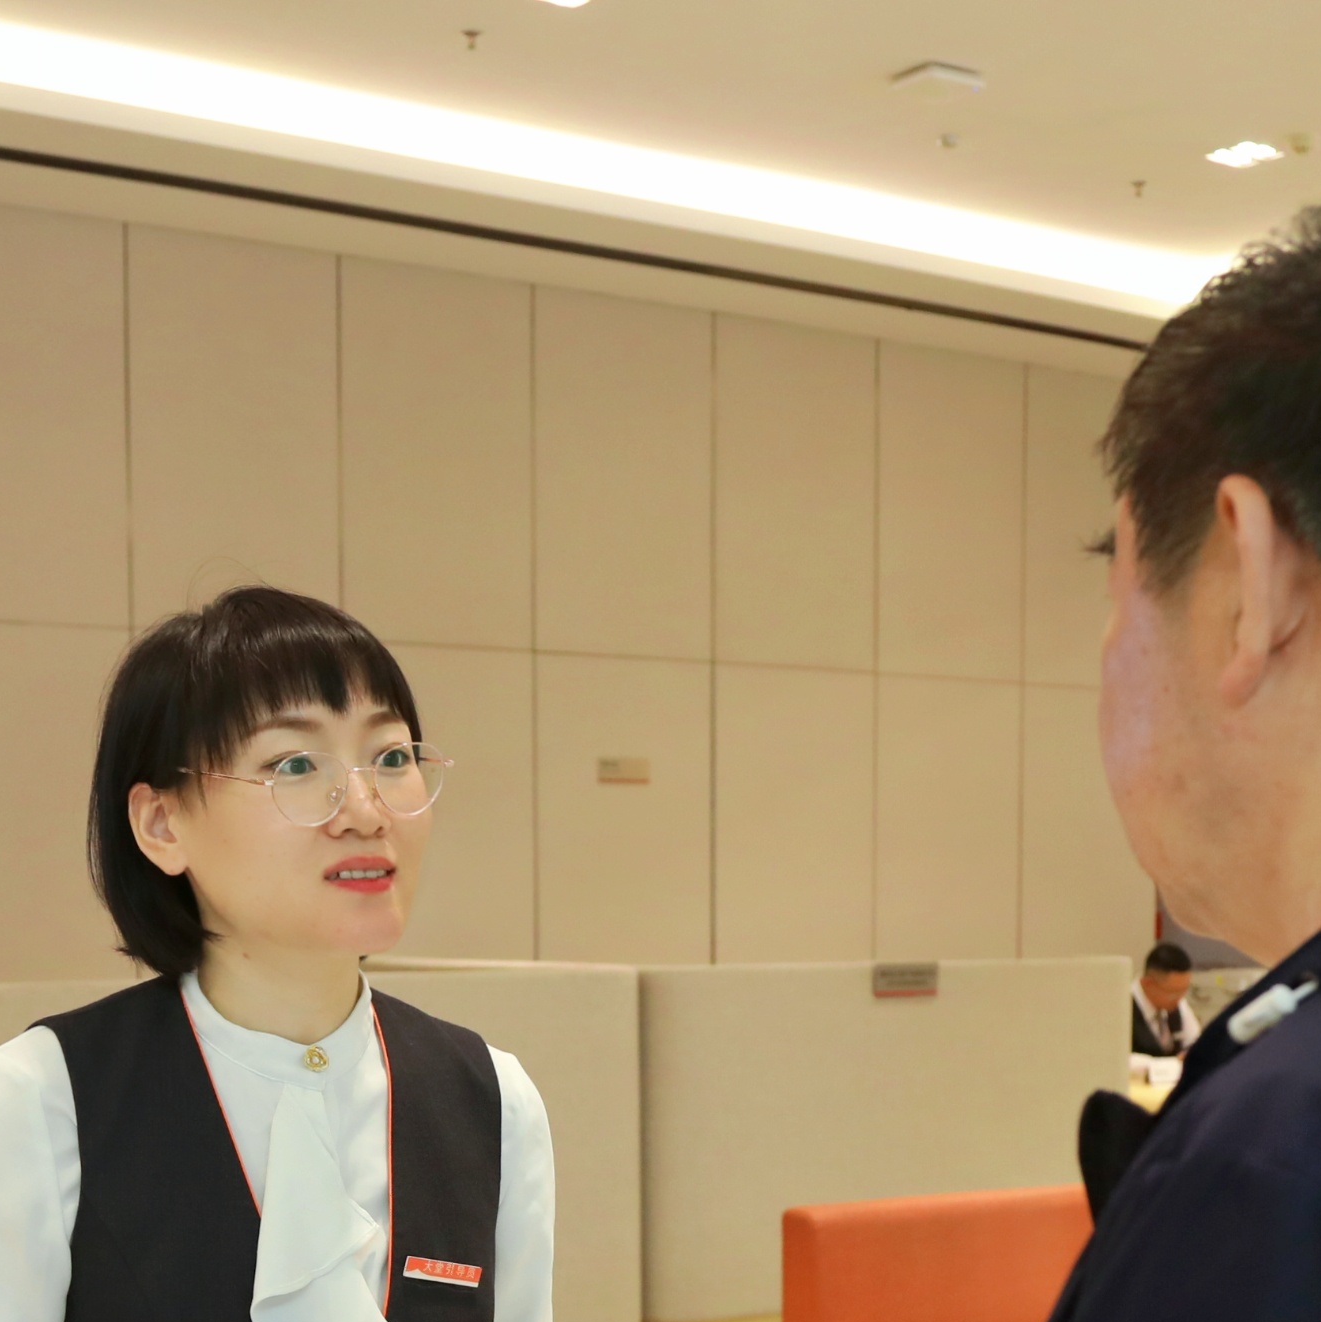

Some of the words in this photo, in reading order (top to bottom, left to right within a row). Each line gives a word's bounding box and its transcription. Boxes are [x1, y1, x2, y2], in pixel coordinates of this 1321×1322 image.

[423, 1260, 476, 1279] 大堂引导员
